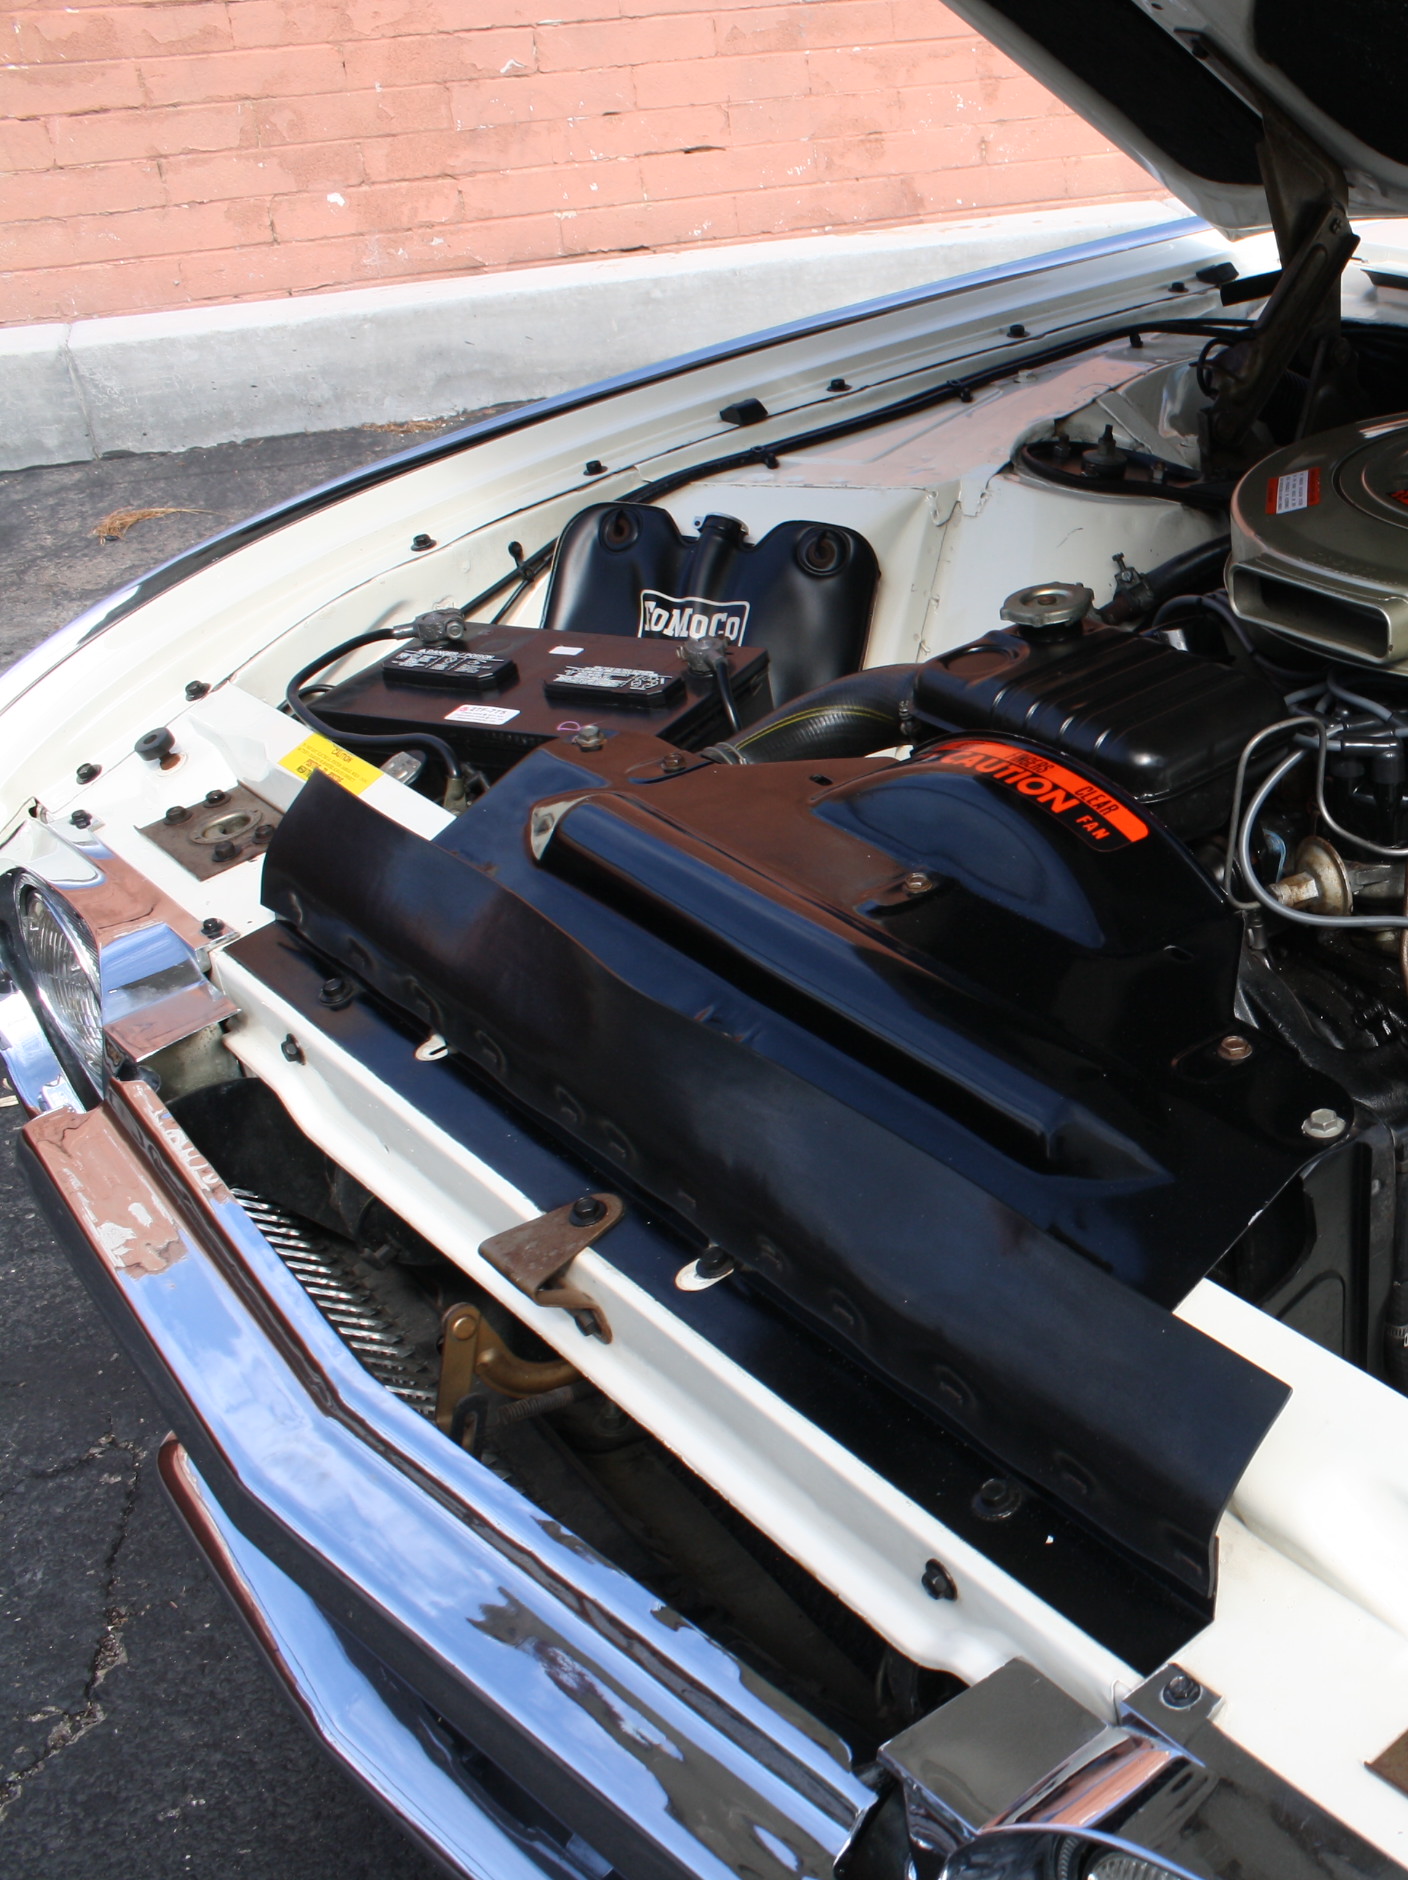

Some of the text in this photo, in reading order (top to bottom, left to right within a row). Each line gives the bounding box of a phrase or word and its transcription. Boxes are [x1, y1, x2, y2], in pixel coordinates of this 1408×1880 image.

[939, 751, 1111, 840] CAUTION FAN
[1074, 786, 1120, 816] CLEAR
